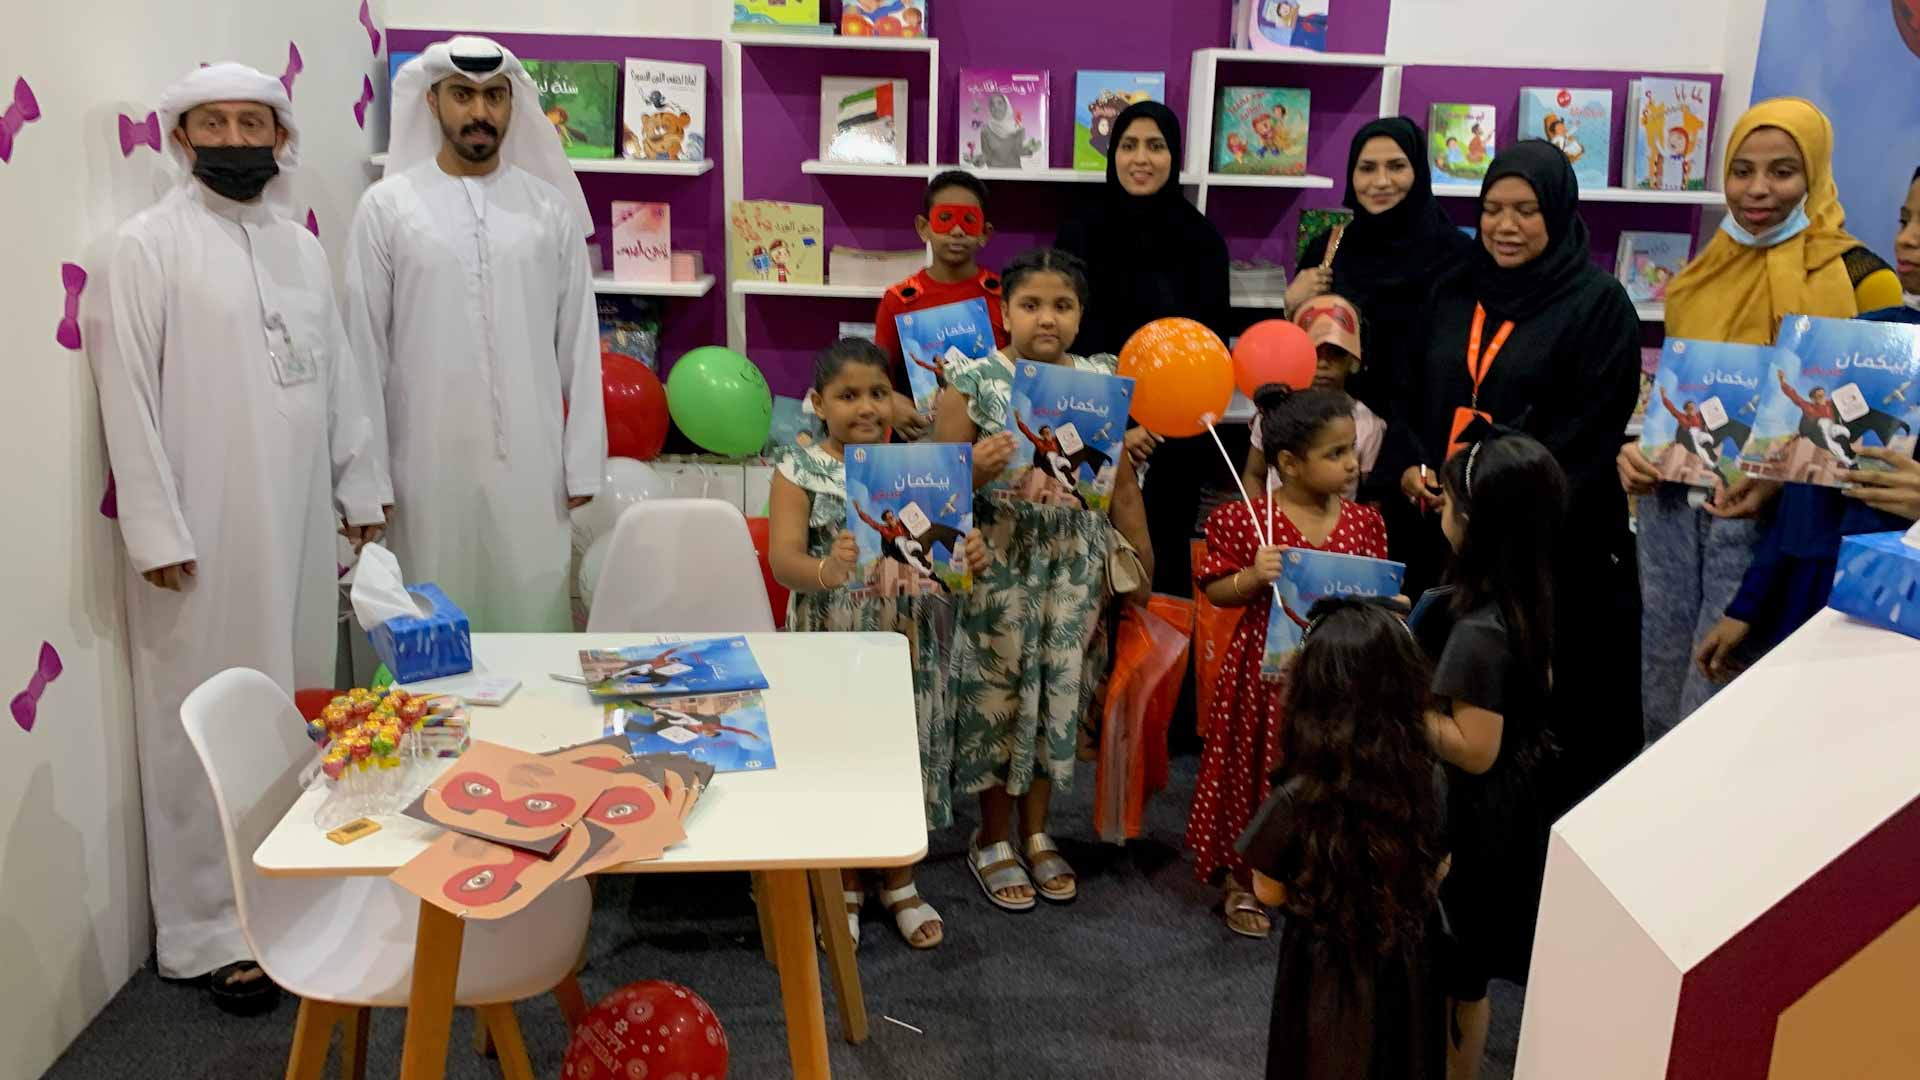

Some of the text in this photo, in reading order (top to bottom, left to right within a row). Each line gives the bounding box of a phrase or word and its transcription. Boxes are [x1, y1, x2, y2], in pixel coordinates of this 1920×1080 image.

[1835, 351, 1908, 375] بيكمان
[1702, 367, 1759, 391] بيكمان
[1055, 395, 1110, 418] بيكمان
[894, 472, 951, 492] بيكمان
